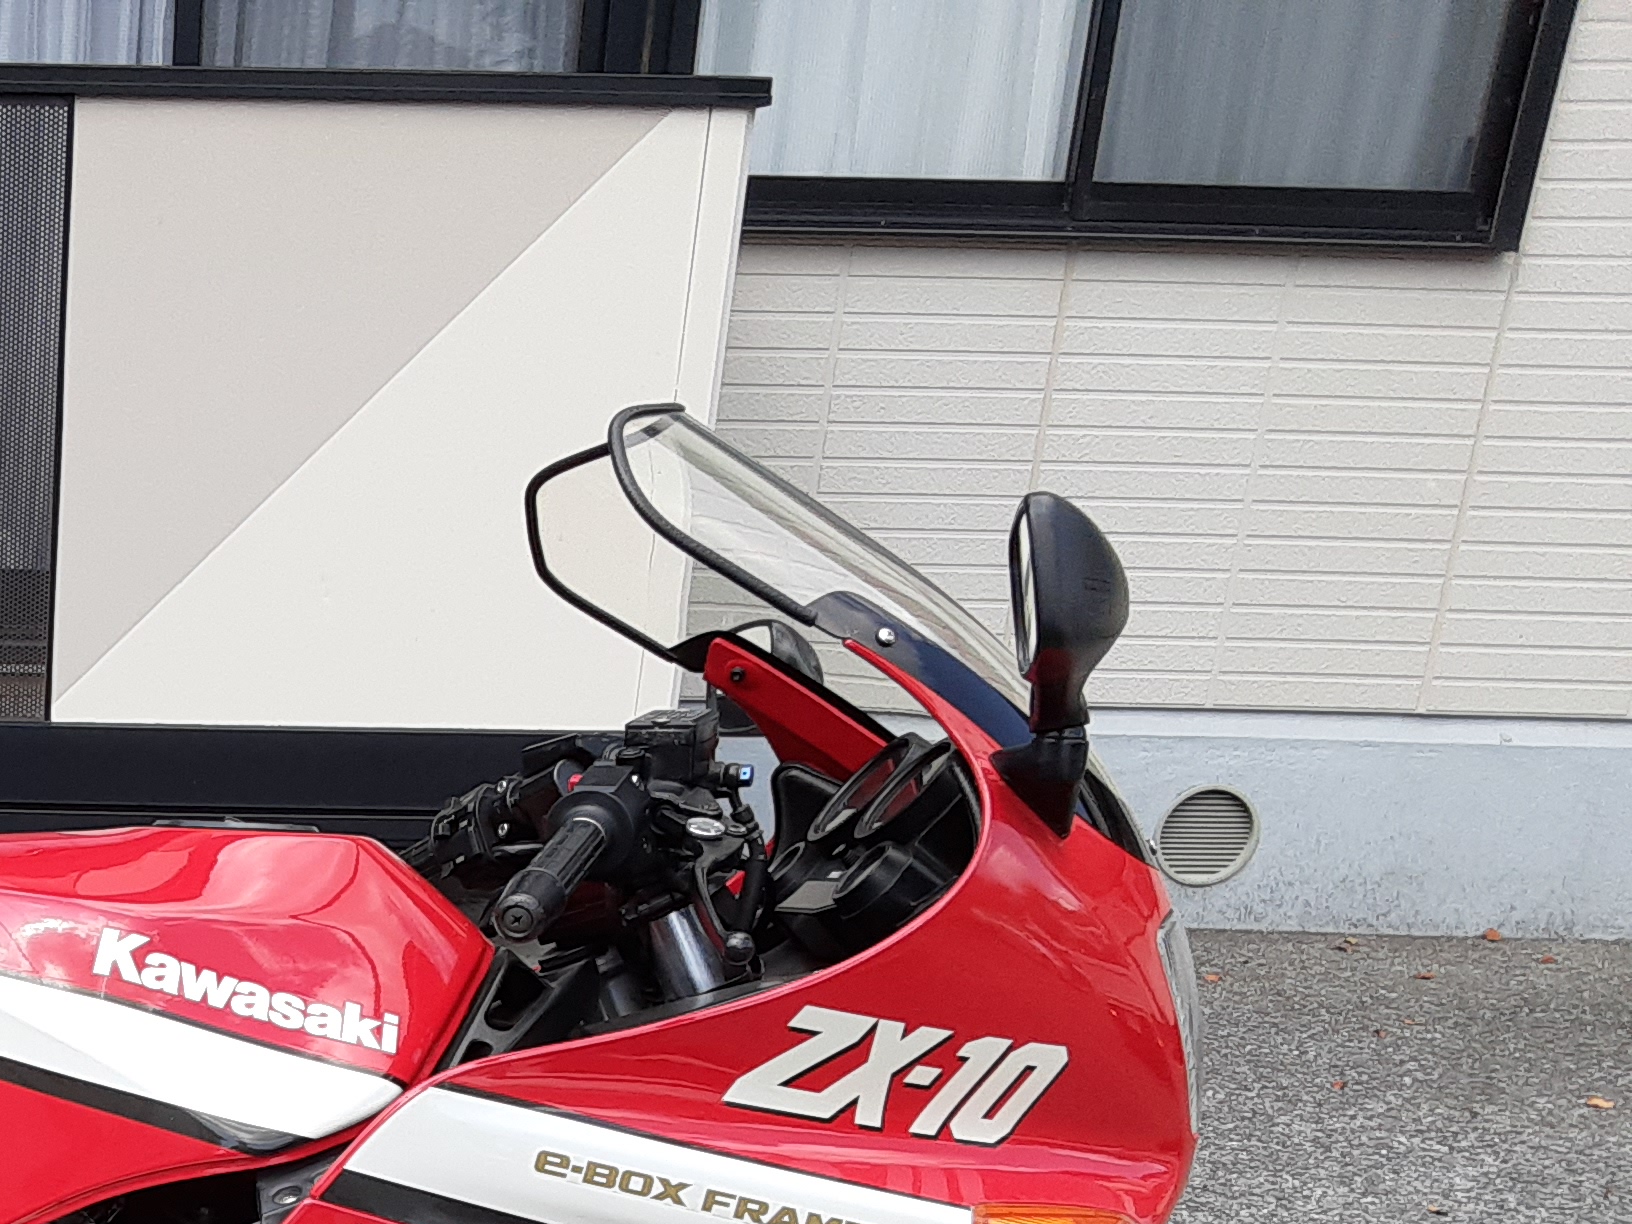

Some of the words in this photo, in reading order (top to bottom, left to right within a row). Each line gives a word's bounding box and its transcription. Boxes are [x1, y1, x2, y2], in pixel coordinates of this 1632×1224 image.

[92, 926, 400, 1055] Kawasaki
[722, 1004, 1069, 1147] ZX-10
[534, 1149, 692, 1207] e-BOX
